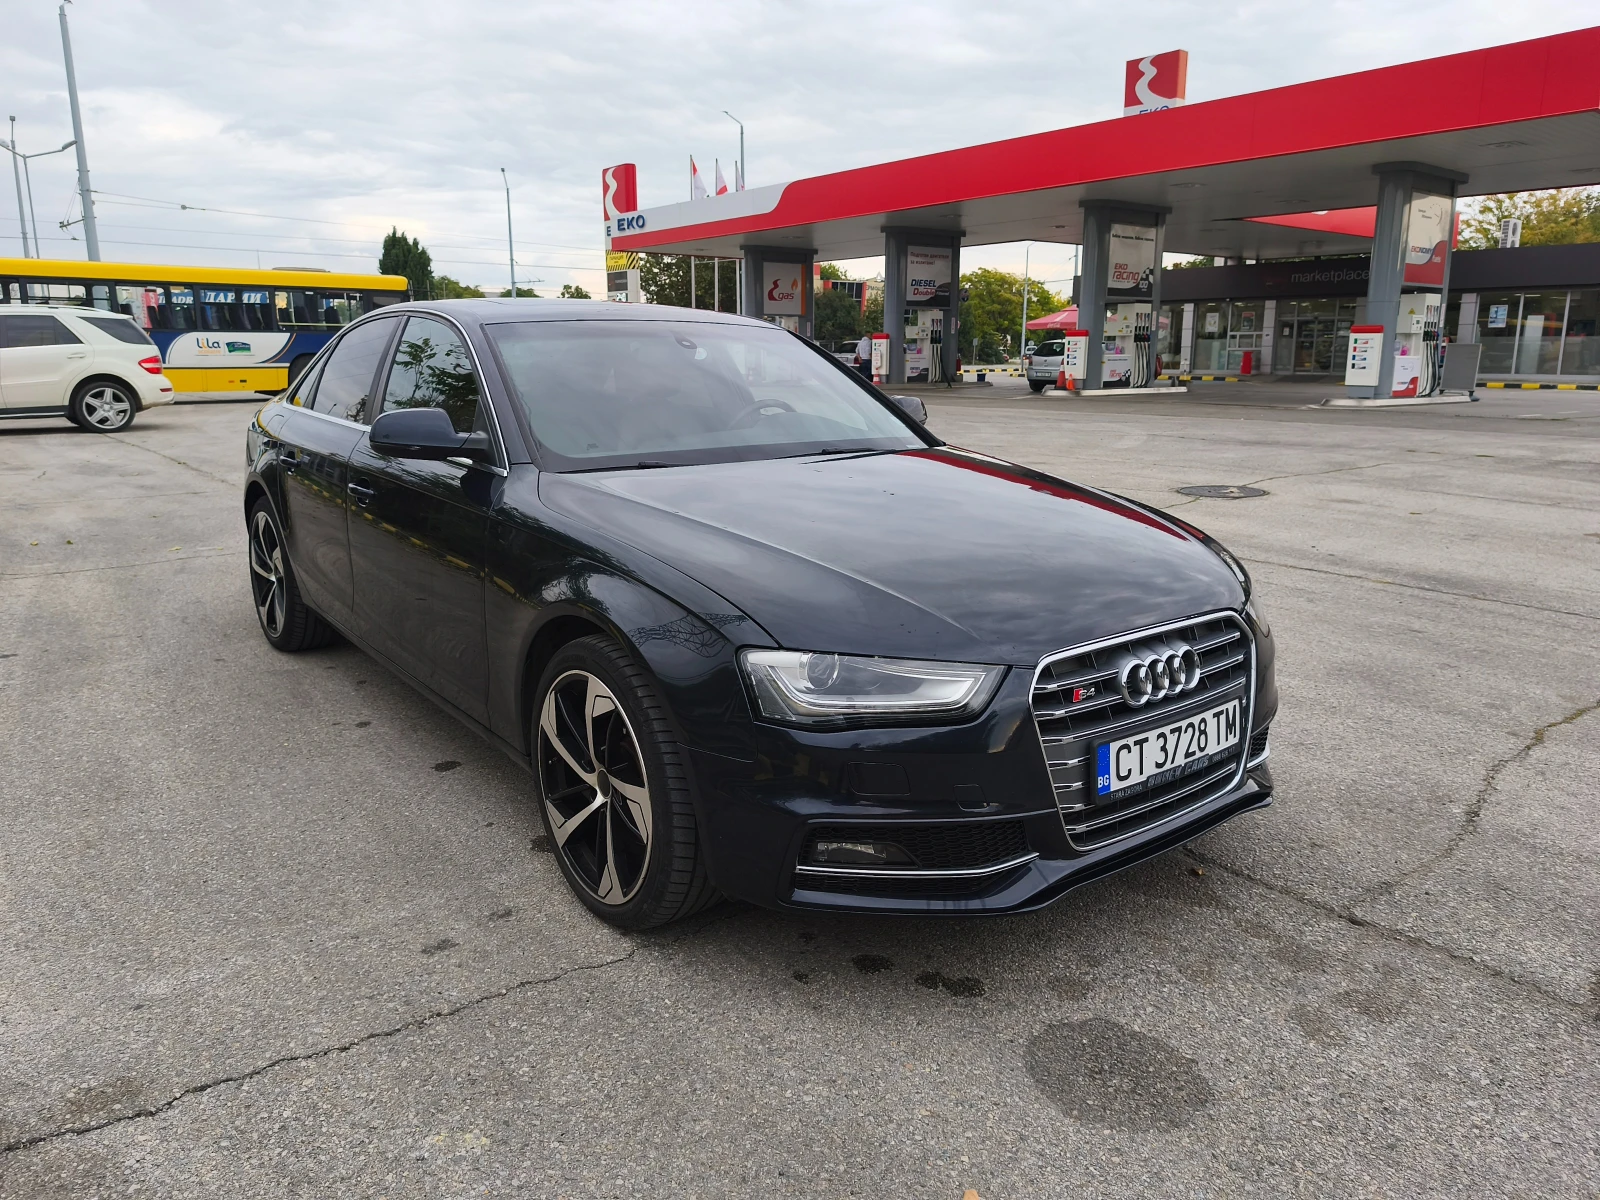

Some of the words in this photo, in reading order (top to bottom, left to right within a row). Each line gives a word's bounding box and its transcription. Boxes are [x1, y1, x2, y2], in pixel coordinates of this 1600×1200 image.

[617, 215, 645, 231] EKO
[1112, 271, 1140, 284] racing
[1291, 269, 1370, 283] marketplace
[911, 279, 936, 287] DIESEL
[1078, 688, 1095, 699] S4
[1115, 736, 1149, 782] CT
[1155, 717, 1208, 769] 3728
[1212, 704, 1237, 746] TM
[1097, 775, 1110, 788] BG
